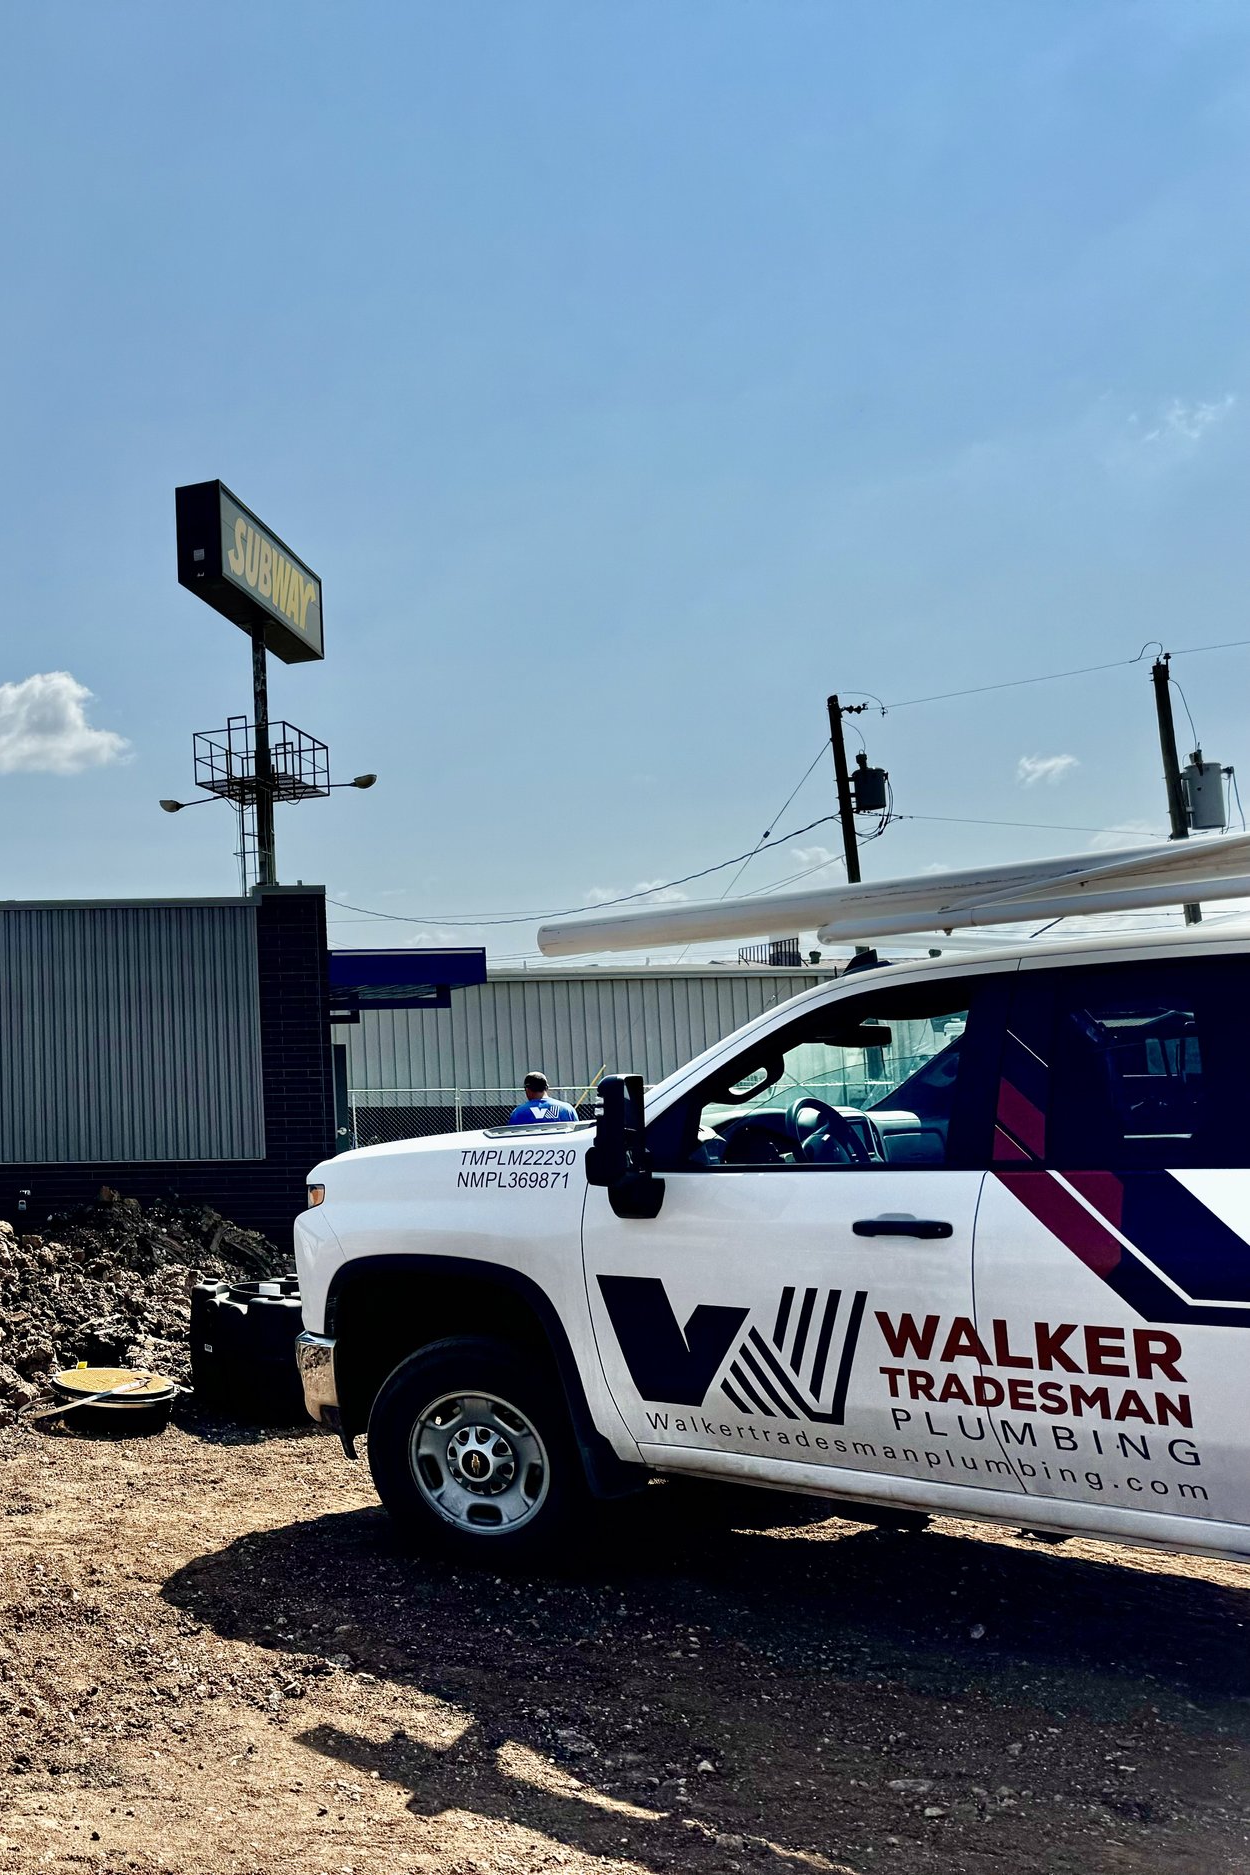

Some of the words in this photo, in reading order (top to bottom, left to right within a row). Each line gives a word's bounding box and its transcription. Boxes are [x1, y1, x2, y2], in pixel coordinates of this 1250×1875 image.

[228, 518, 316, 630] SUBWAY
[457, 1171, 570, 1189] NMPL369871
[461, 1149, 576, 1166] TMPLM22230
[874, 1311, 1188, 1383] WALKER
[879, 1366, 1194, 1429] TRADESMAN
[646, 1411, 1210, 1500] Walkertradesmanplumbing.com
[891, 1407, 1202, 1466] PLUMBING
